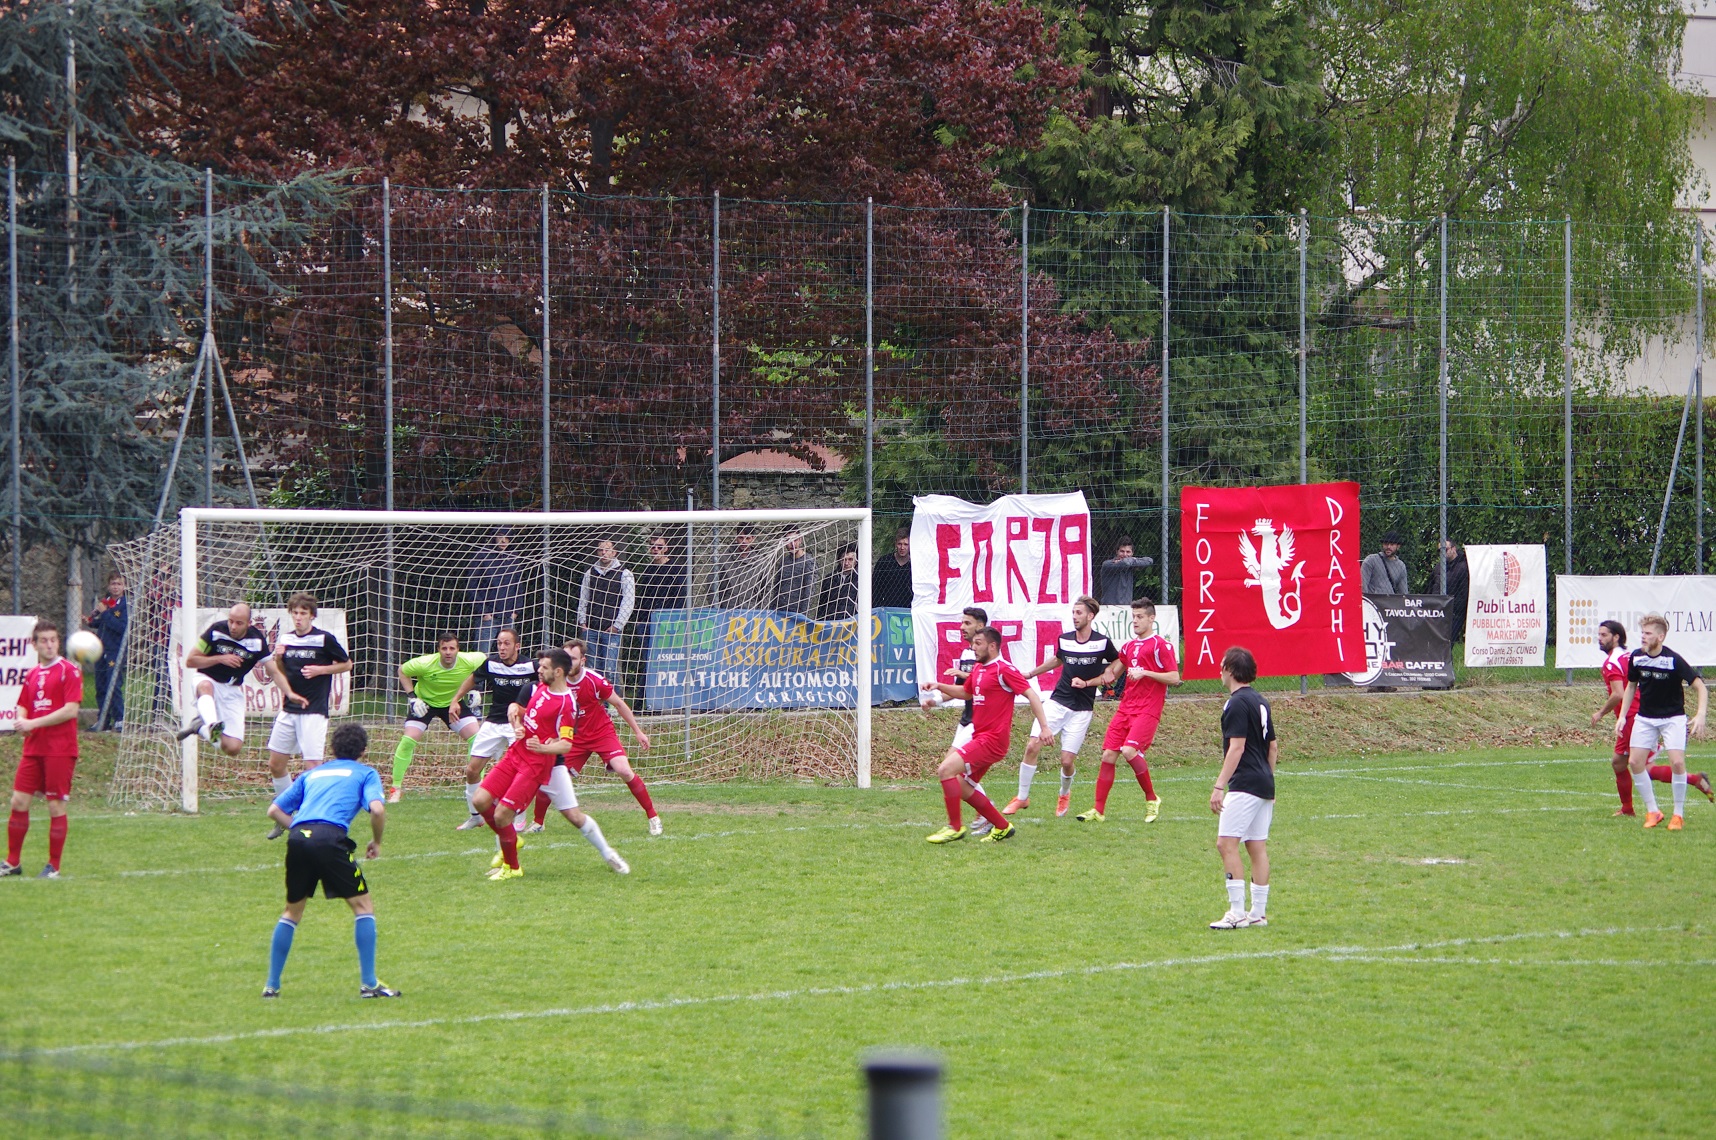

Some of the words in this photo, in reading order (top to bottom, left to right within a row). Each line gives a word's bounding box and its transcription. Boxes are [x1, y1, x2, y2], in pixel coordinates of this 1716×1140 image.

[936, 513, 1088, 604] FORZA
[1196, 503, 1215, 665] FORZA
[1325, 496, 1345, 662] DRAGHI
[1404, 599, 1422, 607] BAR
[1476, 599, 1505, 613] Publi
[1508, 599, 1536, 613] Land
[1384, 609, 1416, 617] TAVOLA
[1417, 610, 1445, 618] CALDA
[1517, 618, 1541, 628] DESIGN
[1607, 611, 1713, 632] EURSTAM
[1486, 630, 1528, 640] MARKETING
[657, 652, 712, 660] ASSICURZIONI
[1472, 646, 1488, 655] Corso
[1516, 646, 1538, 654] CUNEO
[657, 671, 750, 688] PRATICHE
[759, 667, 918, 688] AUTOMOBIISTIC
[755, 690, 847, 703] CARAGLIO
